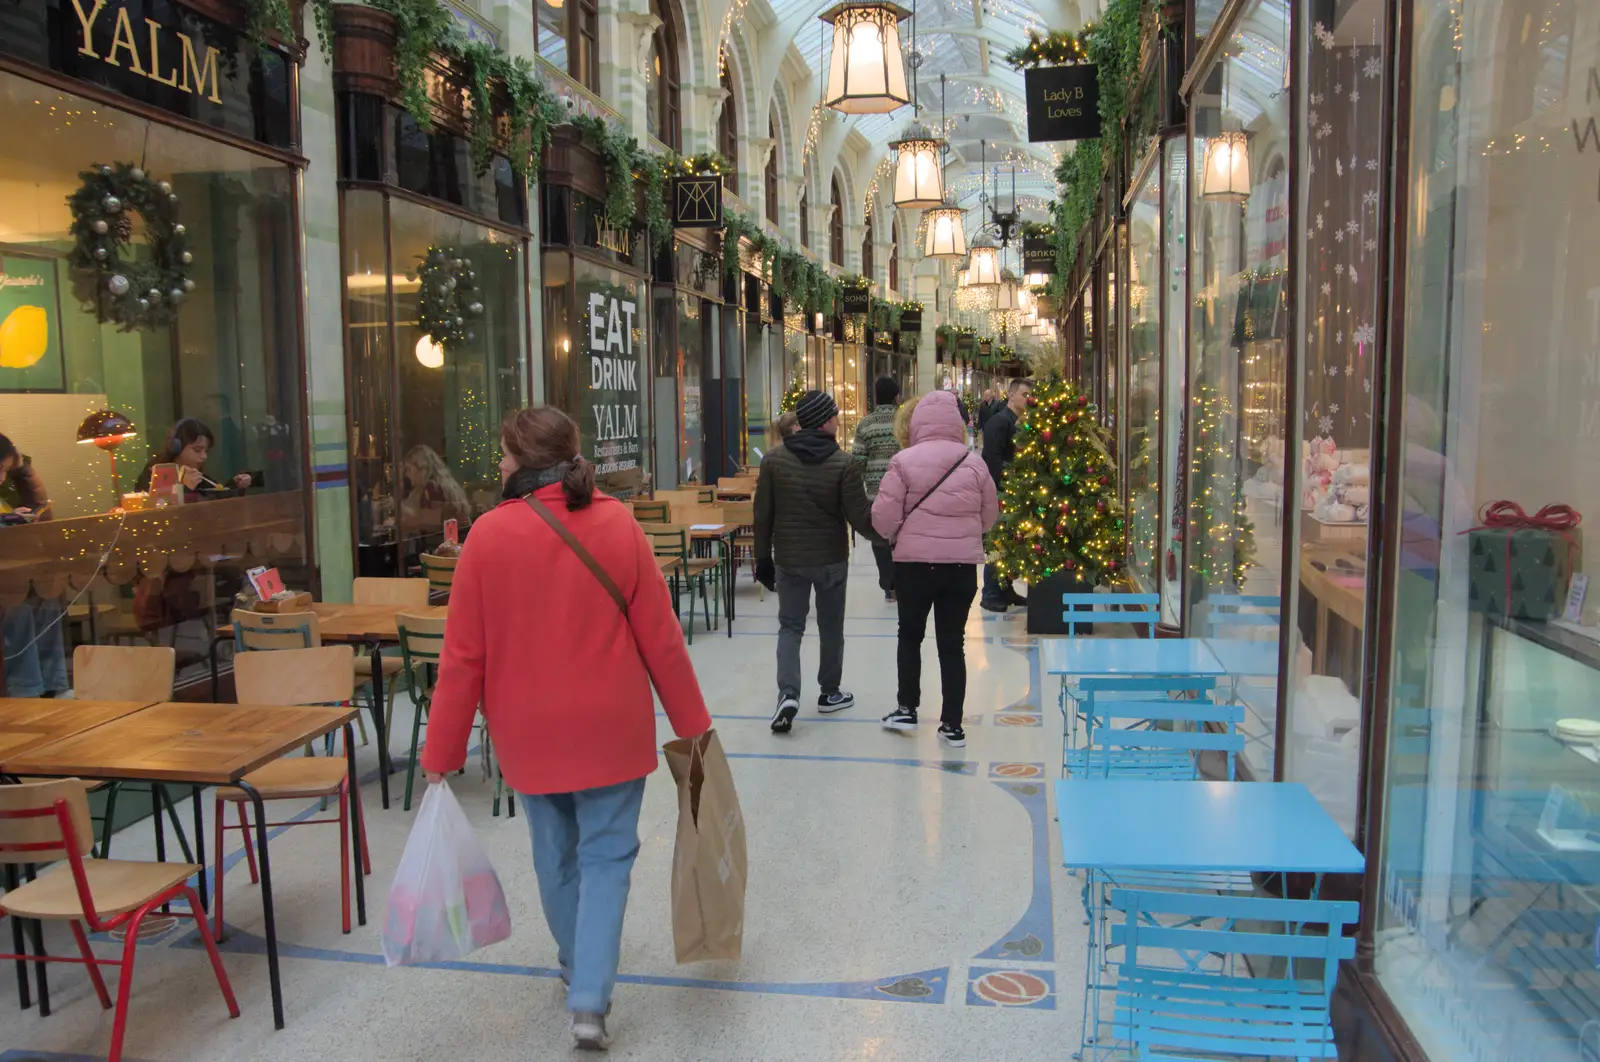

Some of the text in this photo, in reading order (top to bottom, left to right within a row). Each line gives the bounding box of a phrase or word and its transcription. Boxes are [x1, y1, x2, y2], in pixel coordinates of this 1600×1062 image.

[72, 0, 222, 104] YALM
[1043, 86, 1084, 104] Lady B
[1047, 106, 1082, 118] Loves
[594, 214, 630, 256] YALM
[844, 295, 868, 303] SOHO
[589, 292, 635, 354] EAT
[592, 356, 637, 390] DRINK
[592, 404, 638, 440] YALM
[594, 441, 638, 457] Restaurants & Bars
